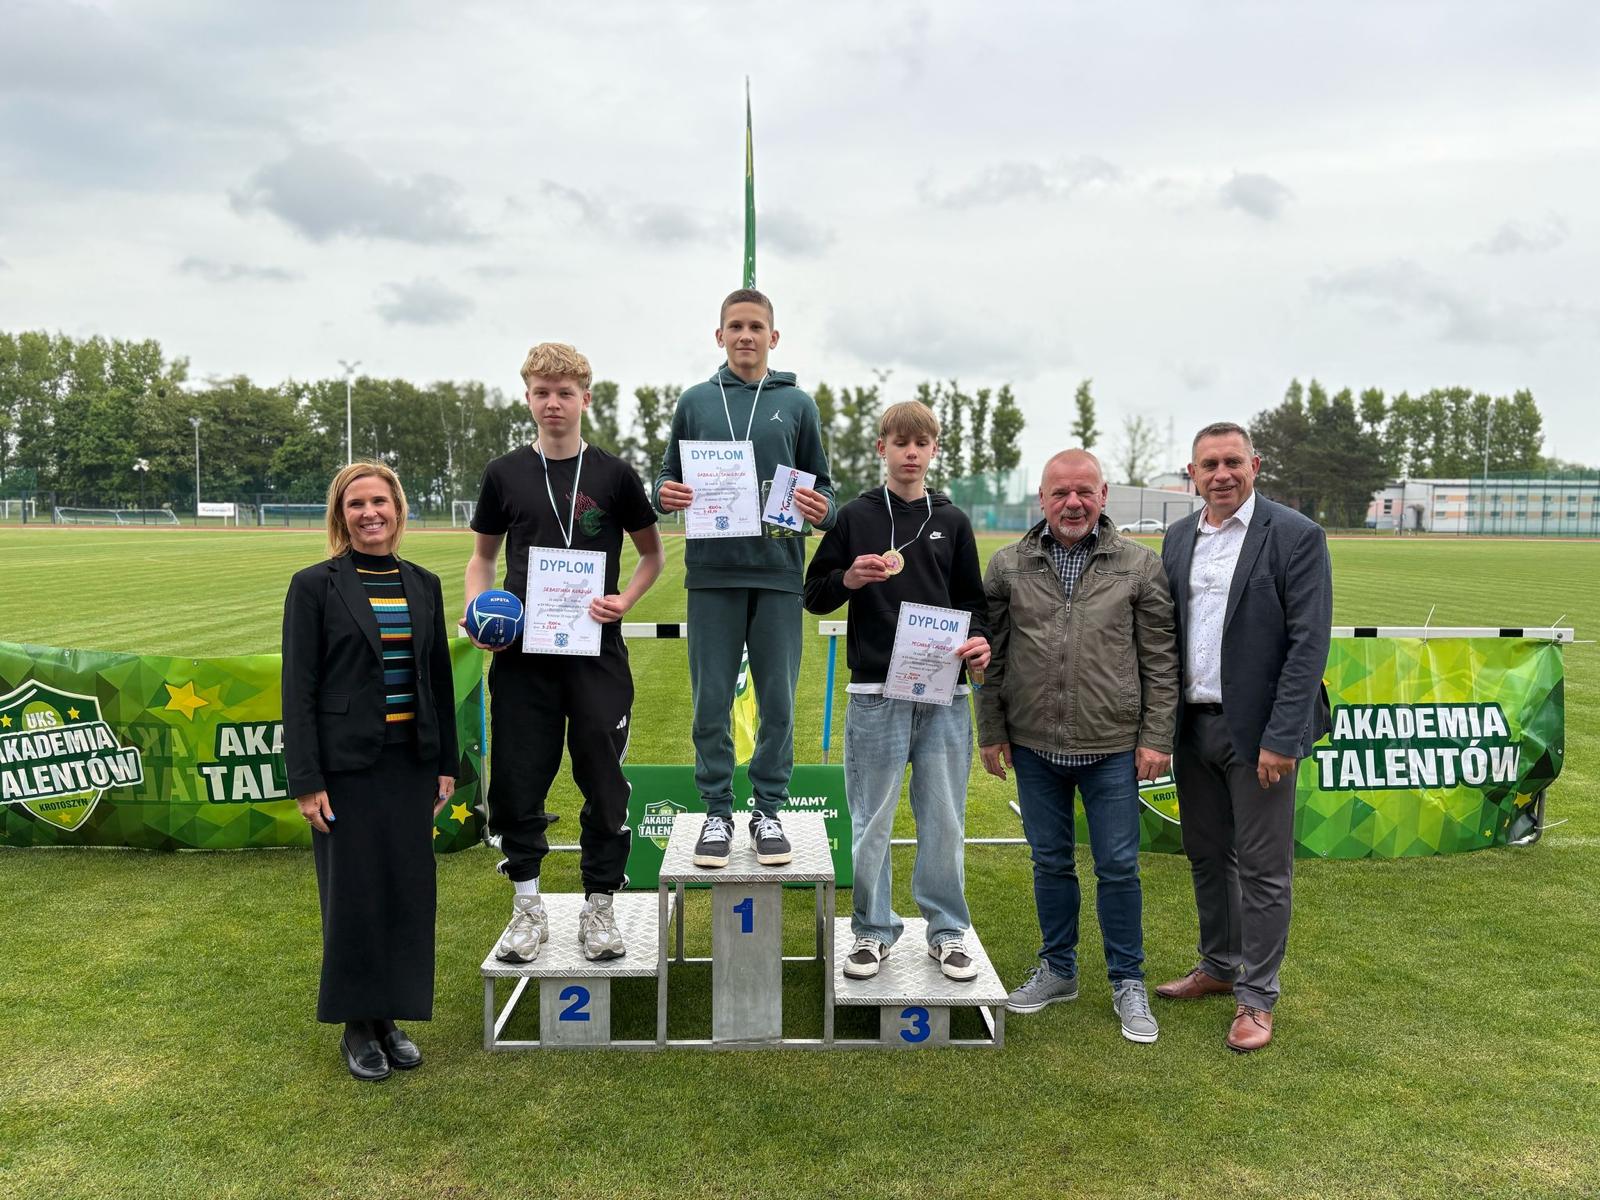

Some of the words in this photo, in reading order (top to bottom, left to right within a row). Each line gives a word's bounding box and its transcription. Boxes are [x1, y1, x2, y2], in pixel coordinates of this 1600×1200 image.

[691, 450, 744, 460] DYPLOM
[540, 559, 594, 574] DYPLOM
[908, 614, 959, 633] DYPLOM
[25, 710, 57, 729] UKS
[1333, 706, 1508, 740] AKADEMIA
[1, 752, 139, 799] ALENTÓW
[1316, 739, 1521, 788] TALENTÓW
[39, 798, 89, 812] KROTOSZYN
[733, 898, 754, 933] 1
[558, 985, 591, 1021] 2
[900, 1006, 931, 1043] 3
